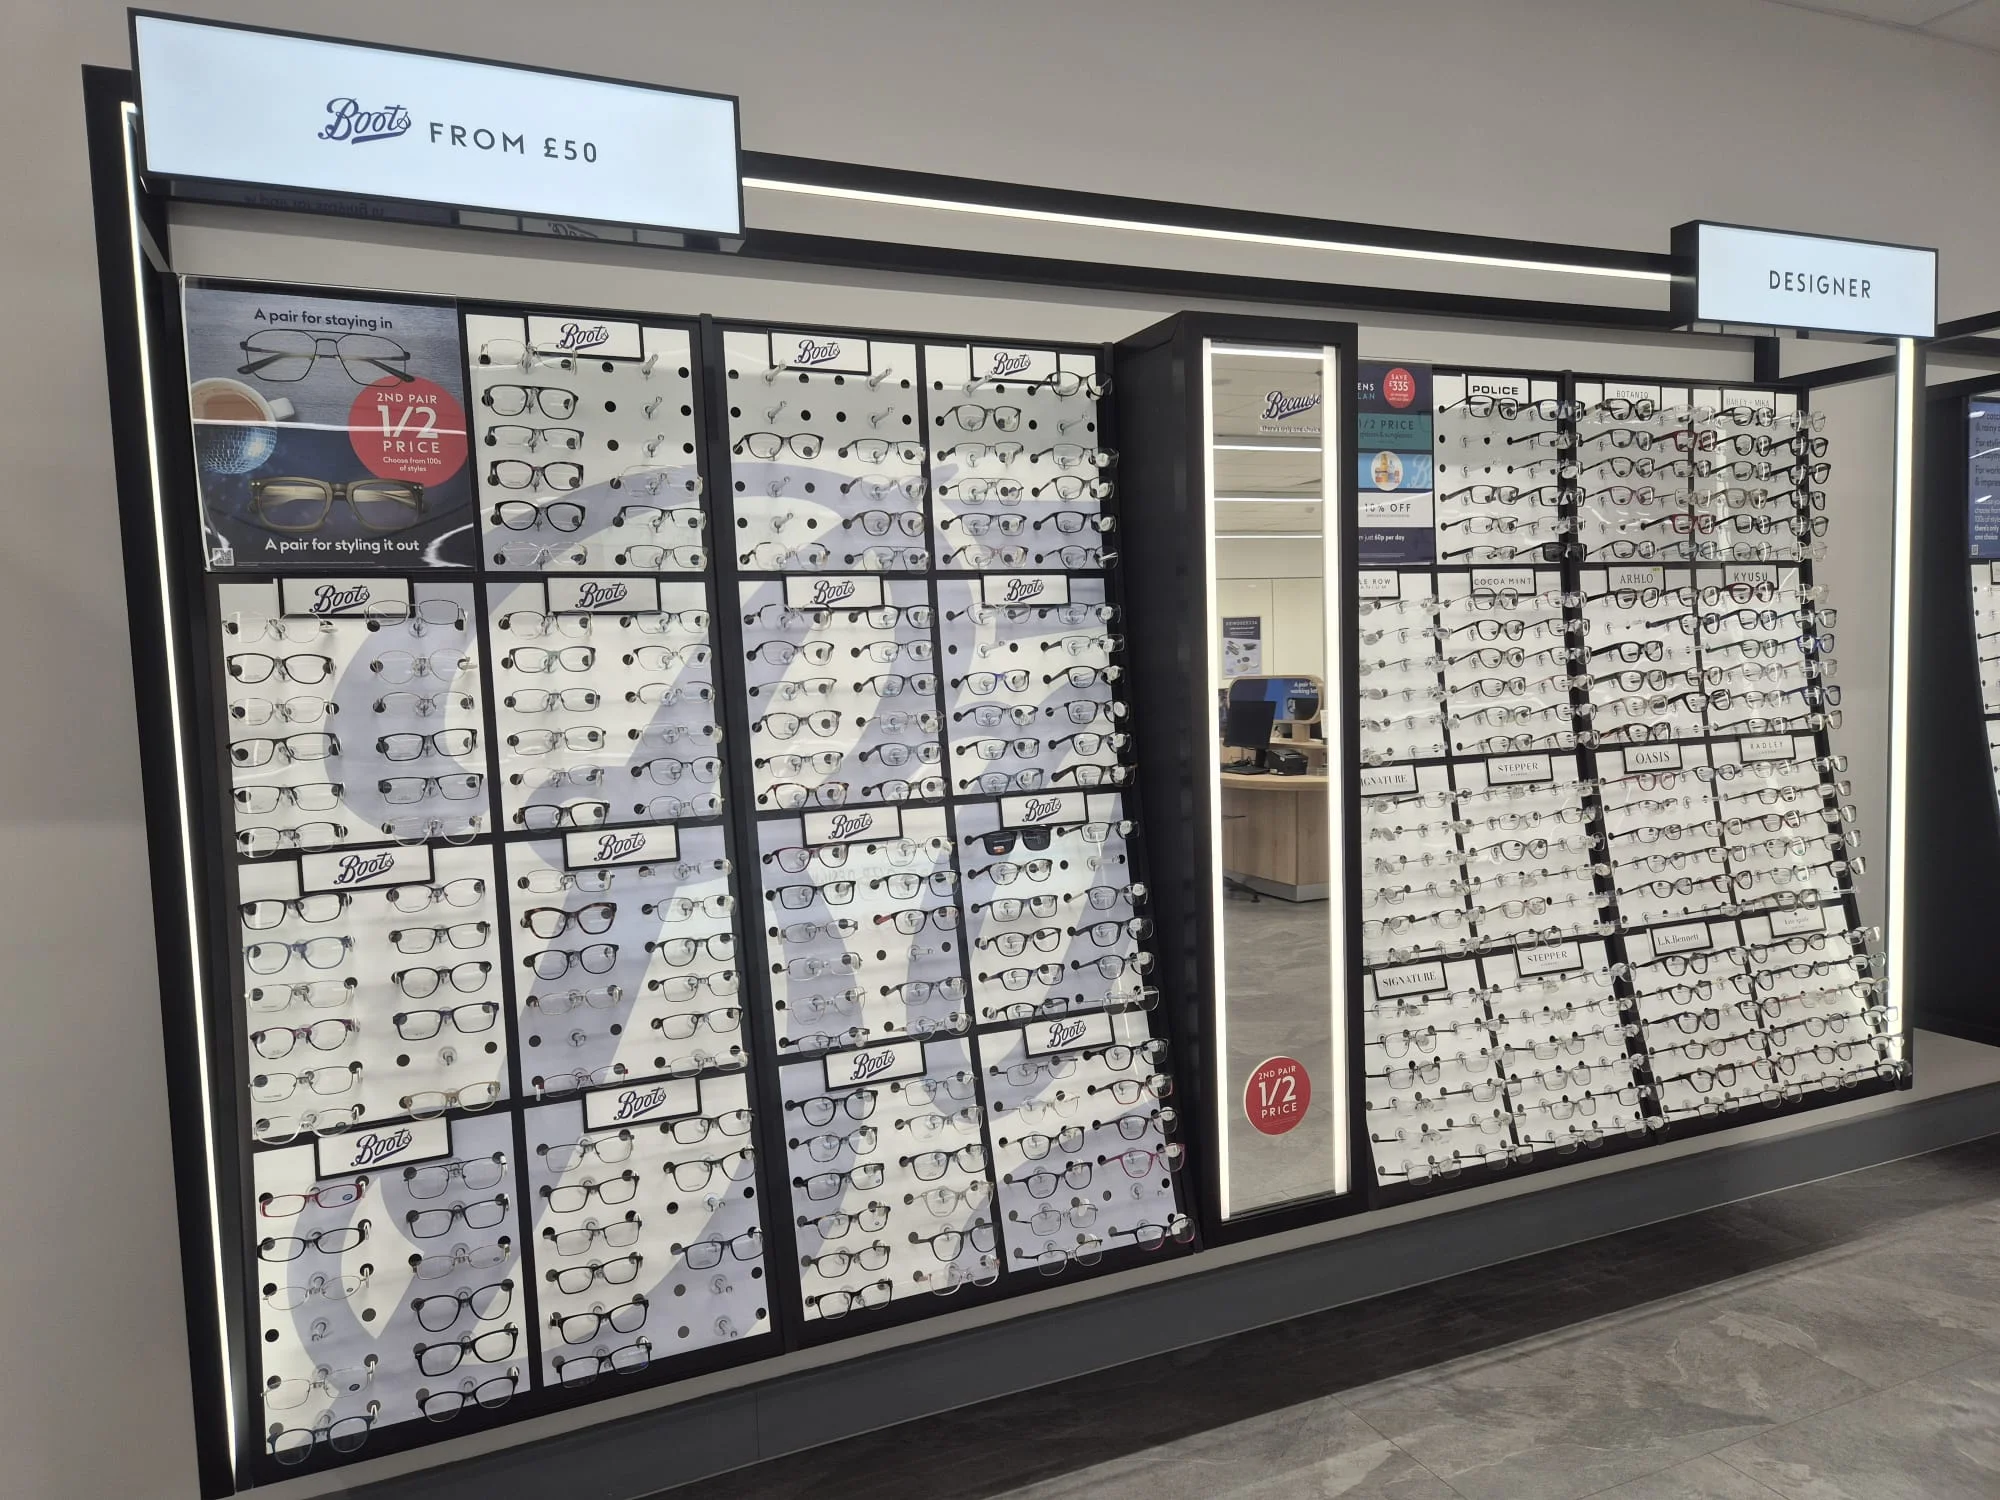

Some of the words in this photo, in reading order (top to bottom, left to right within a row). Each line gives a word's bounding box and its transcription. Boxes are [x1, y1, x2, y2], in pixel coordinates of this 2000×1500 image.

[317, 97, 412, 145] Boots
[429, 121, 526, 155] FROM
[543, 137, 599, 164] £50
[1769, 270, 1872, 299] DESIGNER
[254, 307, 266, 321] A
[269, 310, 299, 325] pair
[302, 310, 322, 324] for
[325, 314, 377, 331] staying
[380, 316, 393, 329] in
[556, 322, 609, 350] Boots
[794, 339, 840, 365] Boots
[989, 351, 1031, 376] Boots
[1391, 373, 1408, 381] SAVE
[1357, 382, 1375, 391] ENS
[1388, 381, 1409, 392] £335
[1472, 385, 1520, 396] POLICE
[376, 392, 404, 402] 2ND
[408, 394, 438, 404] PAIR
[1262, 390, 1321, 419] Because
[1357, 392, 1376, 400] LAN
[377, 404, 439, 439] 1/2
[1380, 419, 1415, 430] PRICE
[383, 440, 441, 454] PRICE
[382, 456, 409, 464] Choose
[409, 457, 426, 465] from
[426, 457, 442, 465] 100s
[399, 464, 407, 472] of
[408, 465, 427, 473] styles
[1390, 503, 1412, 513] OFF
[264, 537, 277, 551] A
[279, 538, 309, 554] pair
[311, 537, 332, 551] for
[335, 538, 381, 554] styling
[383, 539, 394, 551] it
[396, 540, 420, 551] out
[1474, 578, 1505, 586] COCOA
[1508, 577, 1532, 585] MINT
[1619, 573, 1654, 585] ARHLO
[1733, 571, 1769, 582] KYUSU
[575, 582, 628, 609] Boots
[809, 579, 856, 605] Boots
[1003, 577, 1045, 602] Boots
[309, 585, 370, 613] Boots
[1750, 741, 1784, 750] RADLEY
[1635, 750, 1671, 765] OASIS
[1497, 762, 1539, 773] STEPPER
[1360, 774, 1408, 787] IGNATURE
[1022, 796, 1062, 822] Boots
[828, 811, 873, 840] Boots
[594, 832, 646, 861] Boots
[333, 853, 394, 885] Boots
[1527, 950, 1568, 963] STEPPER
[1382, 971, 1437, 988] SIGNATURE
[1047, 1019, 1087, 1049] Boots
[850, 1049, 895, 1081] Boots
[1258, 1070, 1276, 1081] 2ND
[1277, 1065, 1297, 1076] PAIR
[1258, 1075, 1297, 1107] 1/2
[613, 1090, 667, 1121] Boots
[1261, 1102, 1297, 1119] PRICE
[351, 1125, 413, 1167] Boots
